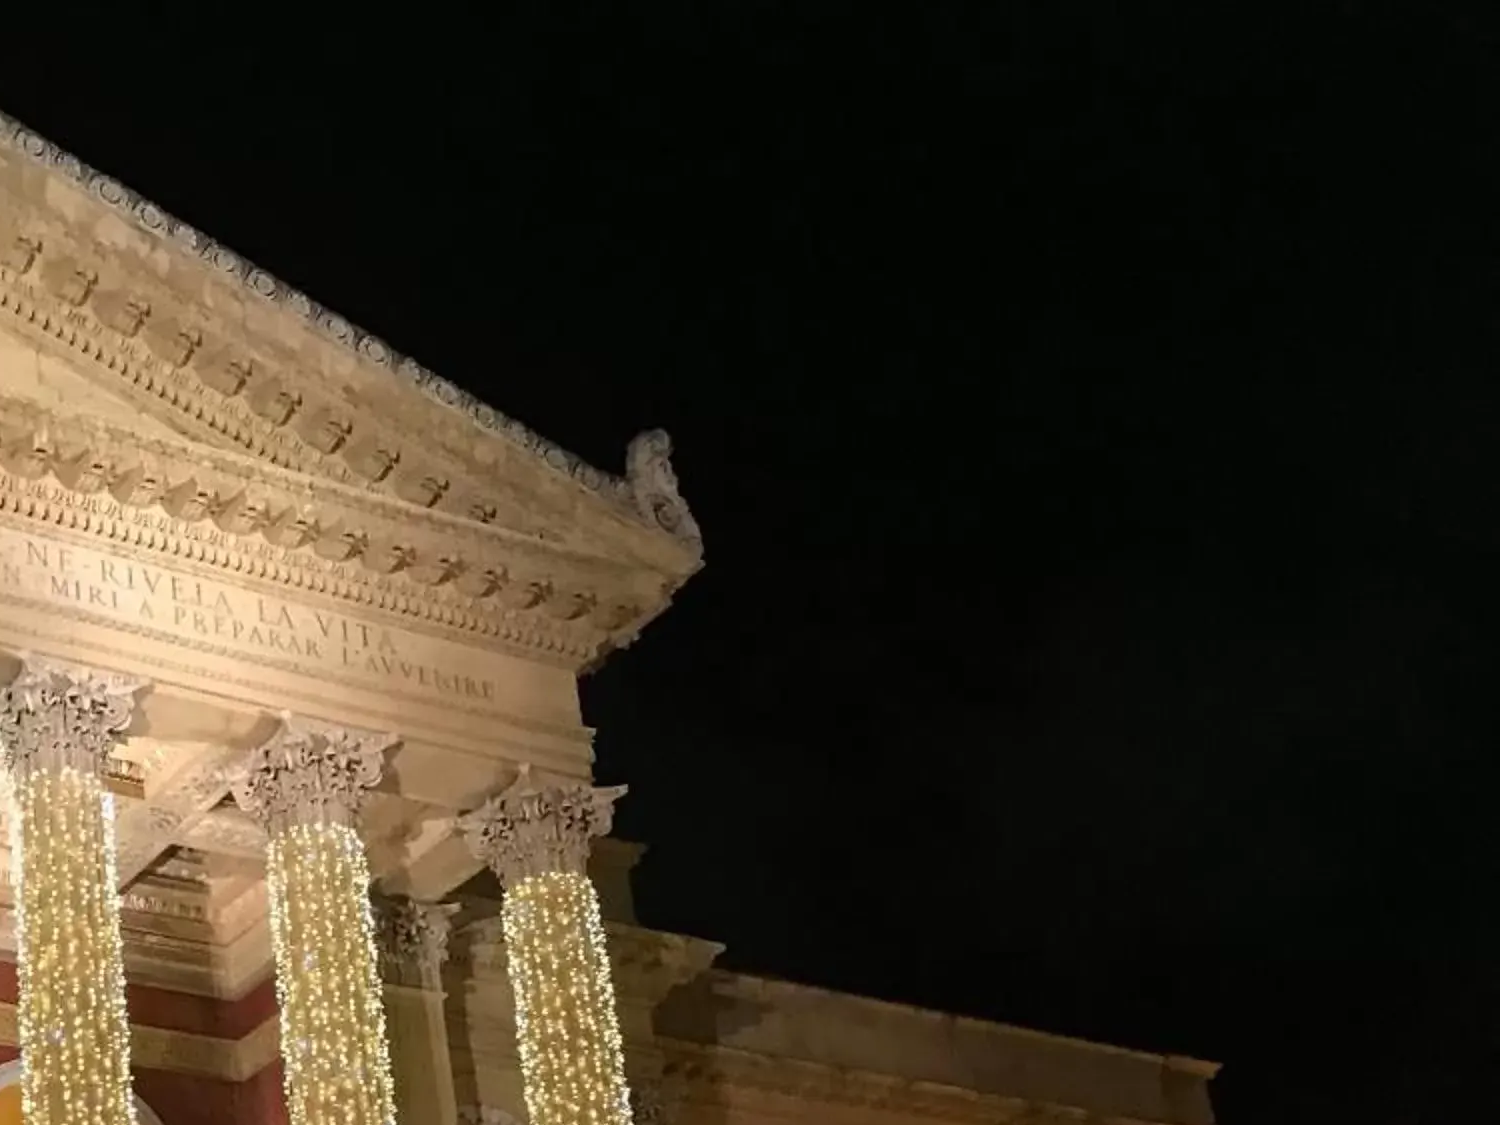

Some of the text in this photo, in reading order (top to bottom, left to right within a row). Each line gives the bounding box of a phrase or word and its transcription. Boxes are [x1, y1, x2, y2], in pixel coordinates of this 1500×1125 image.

[50, 575, 118, 609] MIRI
[173, 605, 323, 659] PREPARAR
[100, 559, 233, 616] RIVELA
[257, 598, 294, 630] LA
[315, 612, 397, 656] VITA
